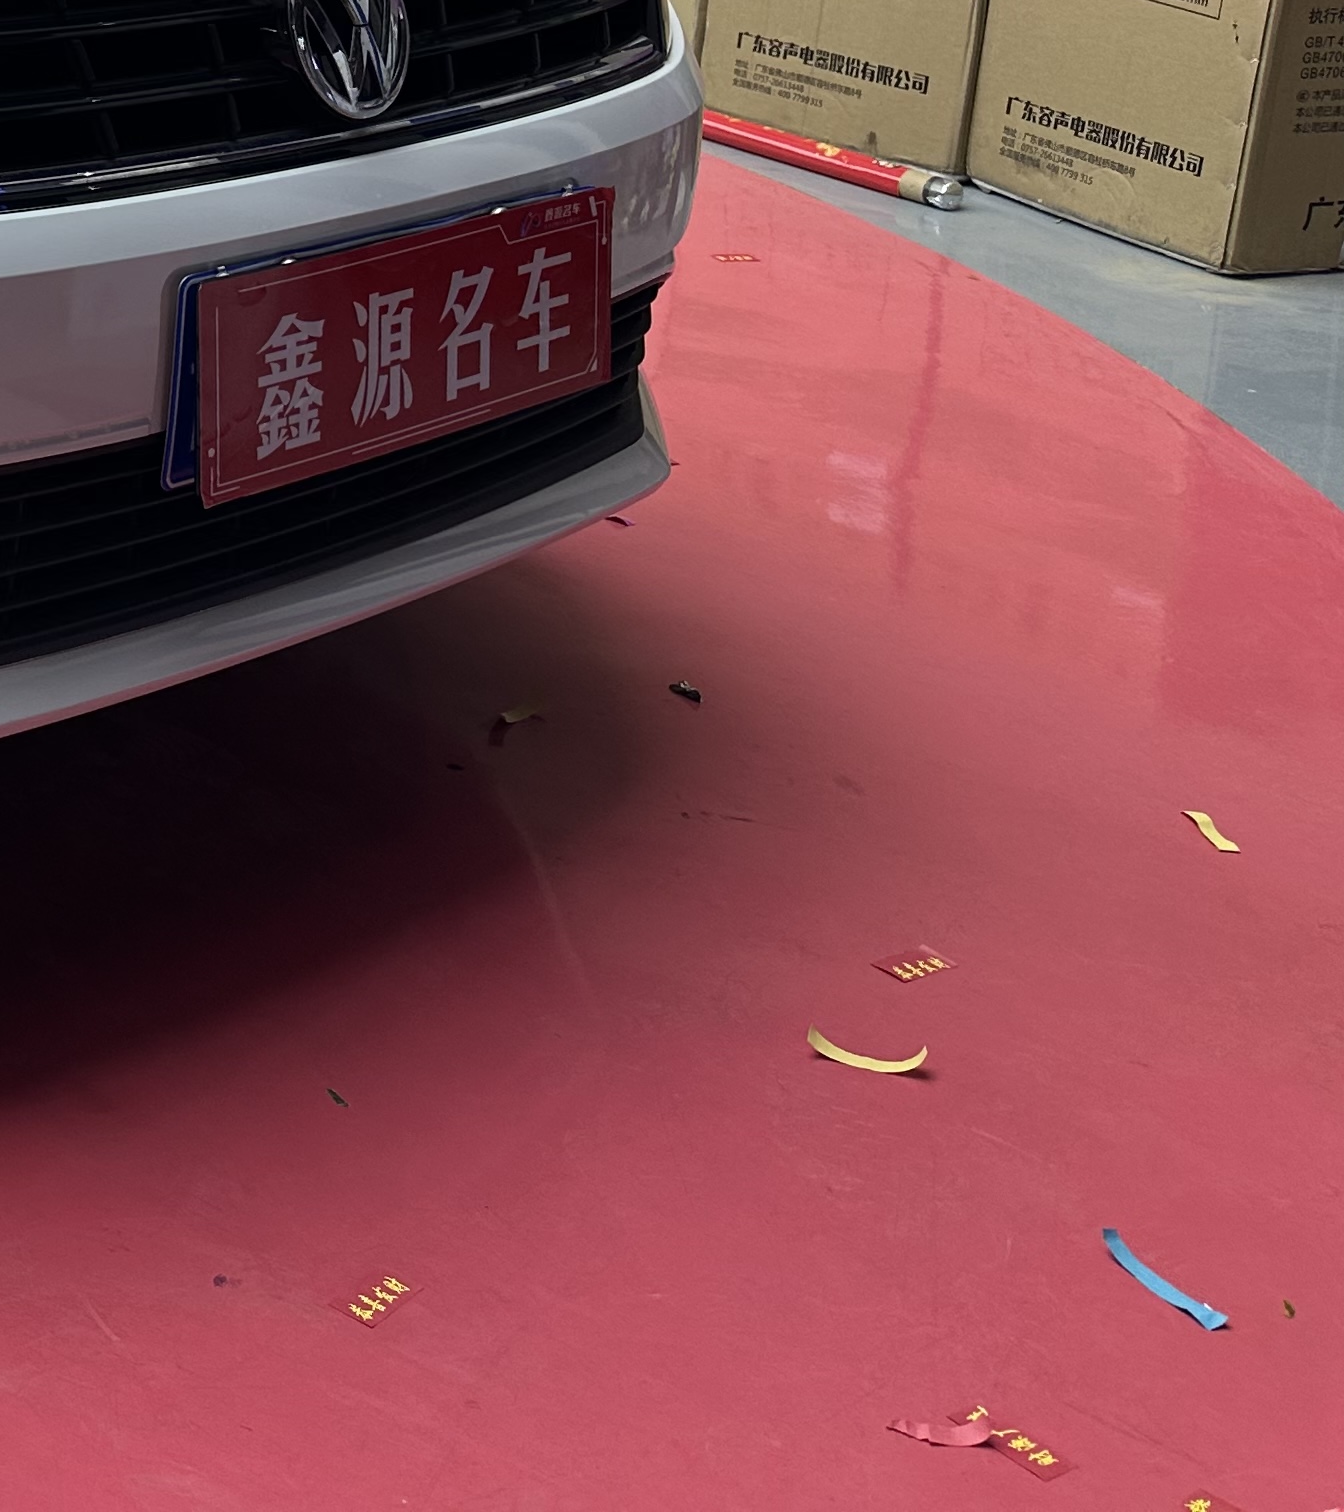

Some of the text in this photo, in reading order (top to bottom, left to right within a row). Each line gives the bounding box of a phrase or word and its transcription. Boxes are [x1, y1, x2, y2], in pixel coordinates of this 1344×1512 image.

[735, 31, 930, 95] 广东容声电器股份有限公司
[1302, 51, 1344, 65] GB470
[1304, 36, 1335, 49] GB/T
[1005, 96, 1205, 177] 广东容声电器股份有限公司
[256, 246, 572, 461] 鑫源名车
